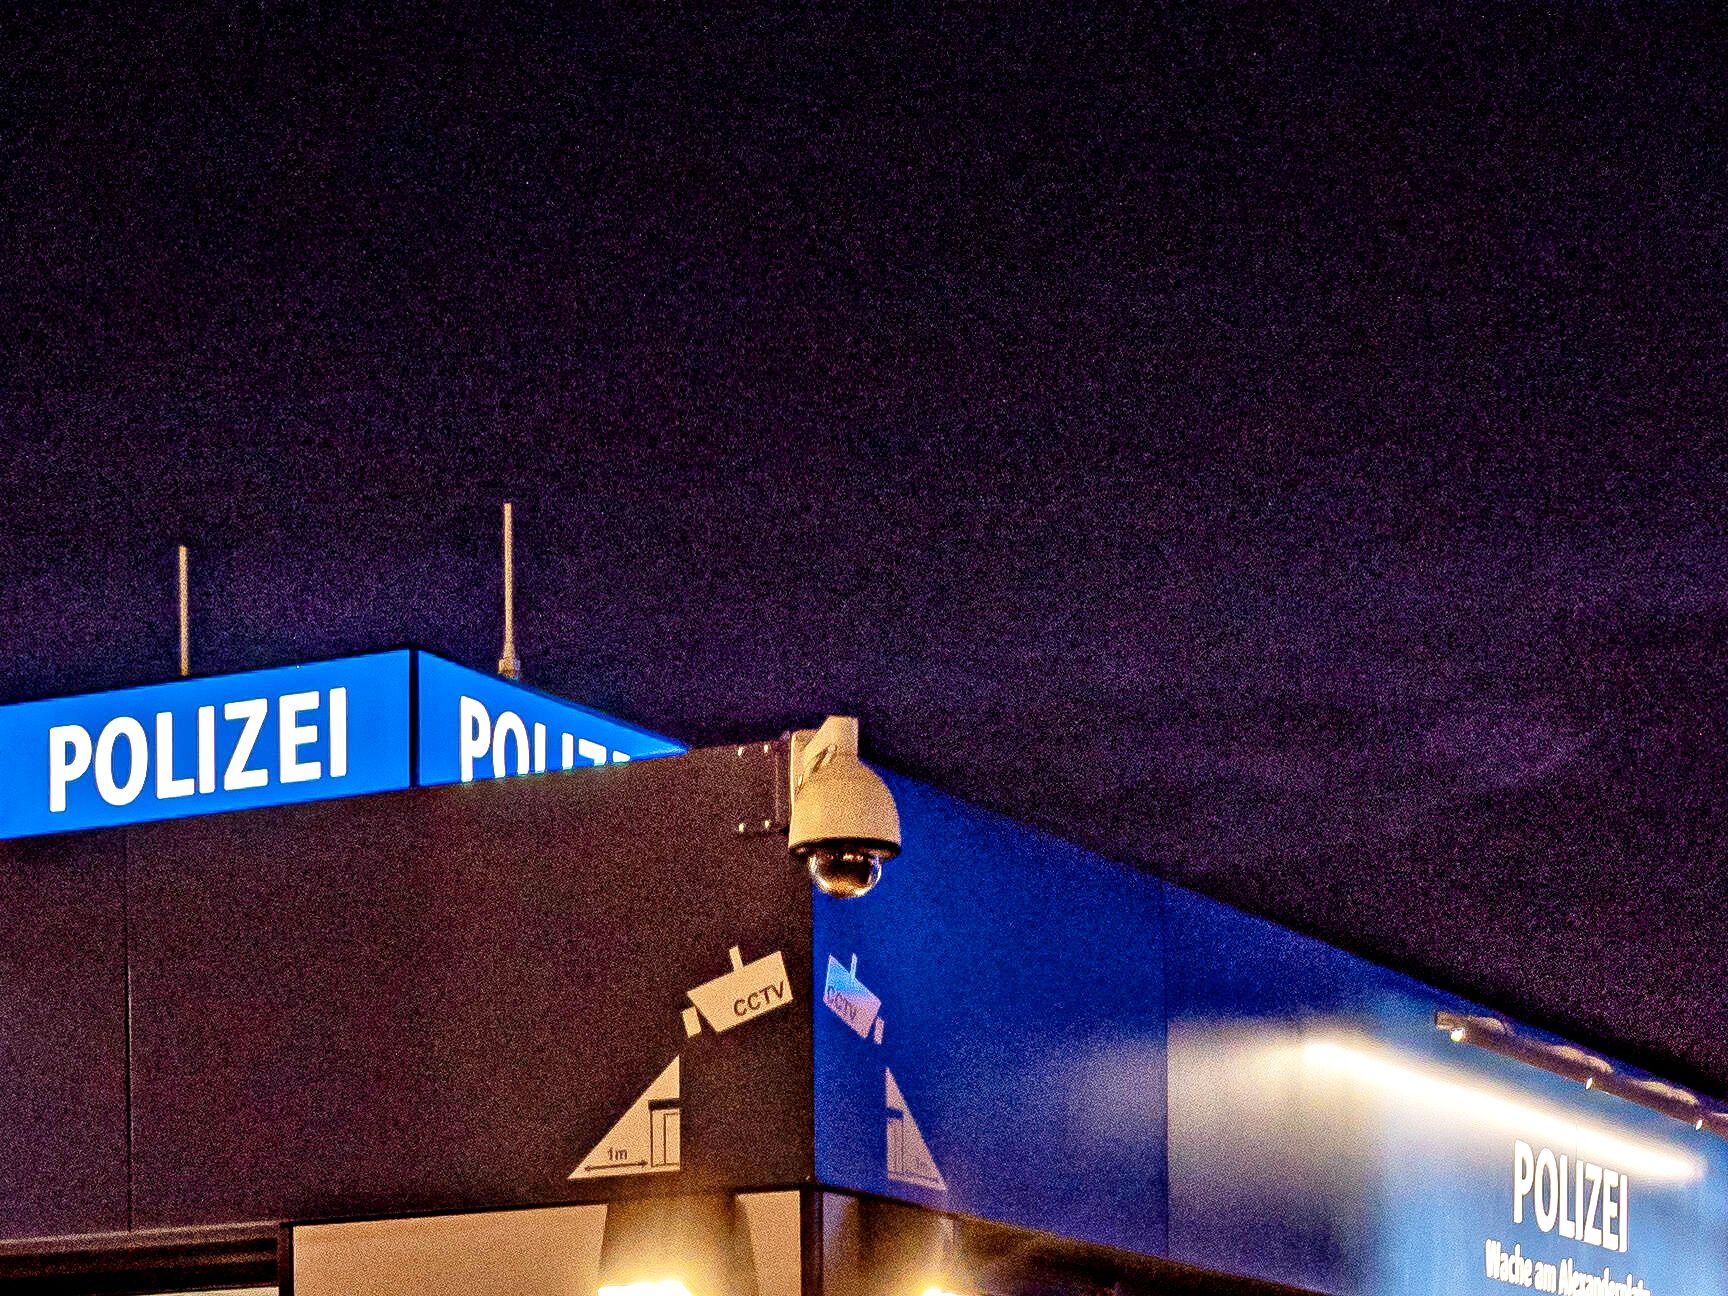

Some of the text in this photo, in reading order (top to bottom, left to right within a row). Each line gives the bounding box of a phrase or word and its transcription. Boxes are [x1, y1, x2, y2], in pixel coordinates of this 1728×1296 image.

[48, 686, 348, 813] POLIZEI
[732, 980, 788, 1018] CCTV
[1512, 1139, 1628, 1253] POLIZEI
[1484, 1238, 1533, 1289] Wache
[1534, 1260, 1558, 1295] am
